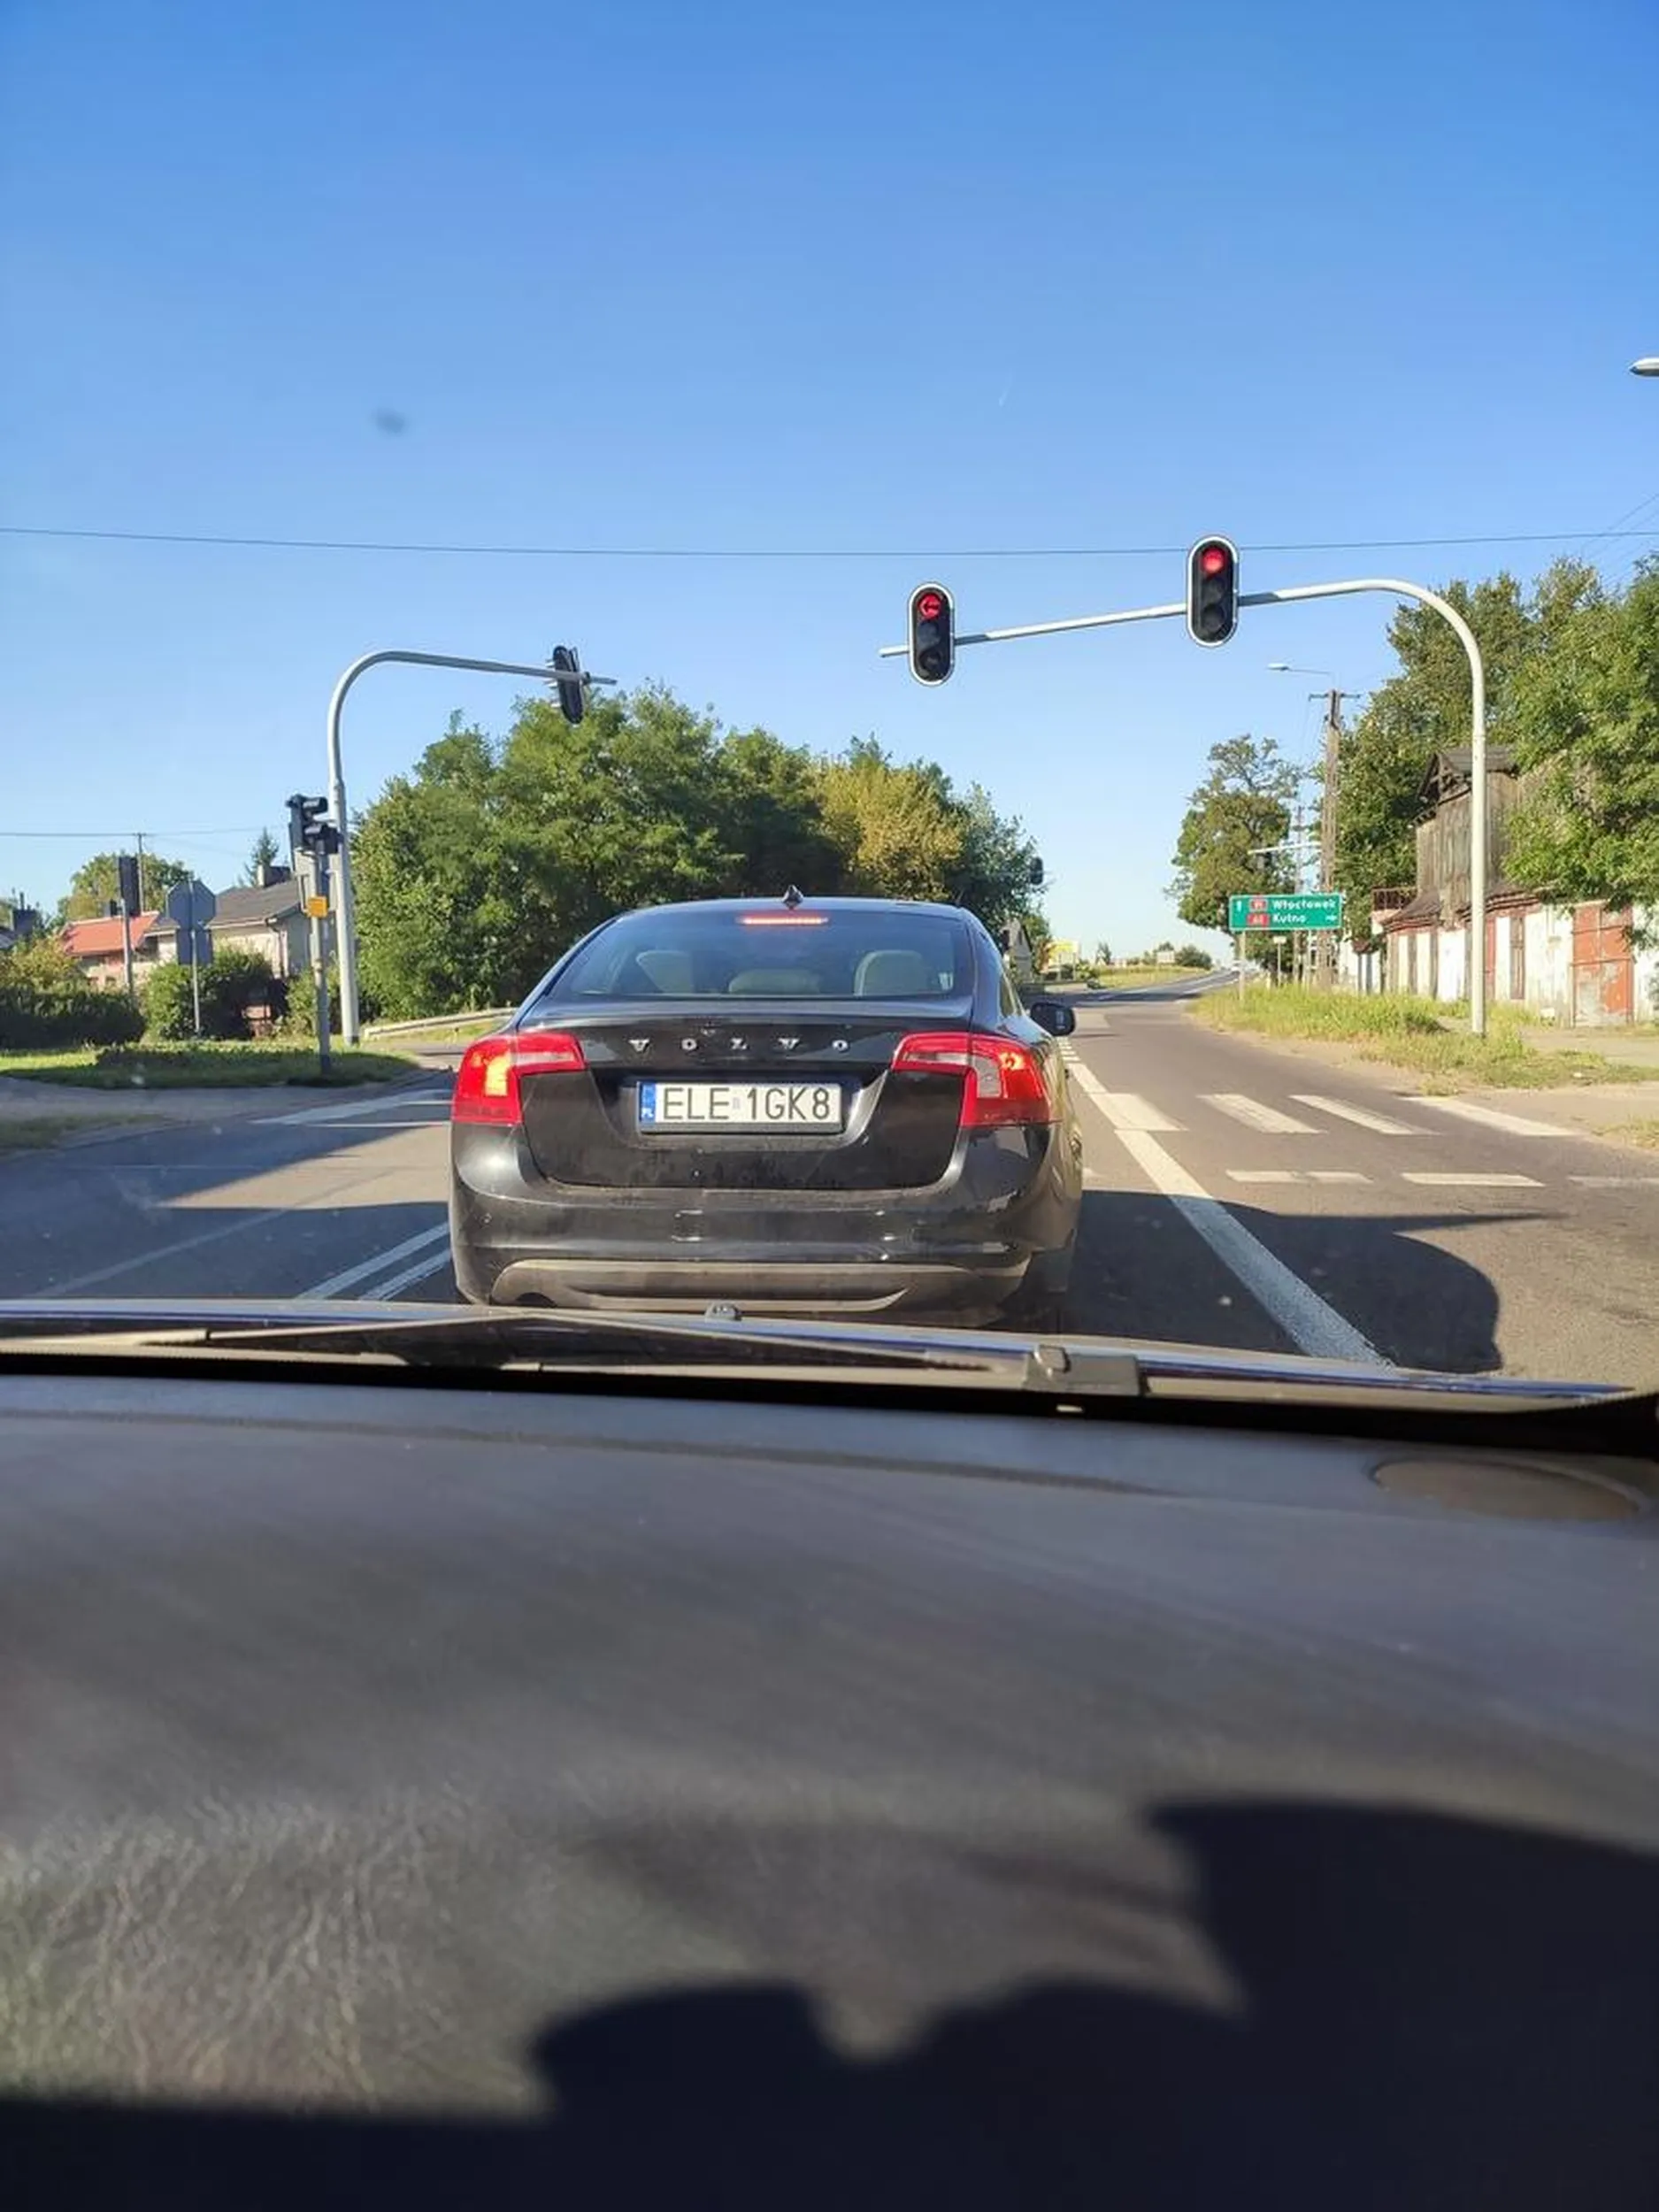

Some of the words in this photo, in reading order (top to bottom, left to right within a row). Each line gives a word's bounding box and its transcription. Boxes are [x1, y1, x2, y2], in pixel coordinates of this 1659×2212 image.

[1272, 913, 1307, 924] Kutno
[629, 1038, 848, 1052] VOLVO
[664, 1087, 730, 1120] ELE
[747, 1087, 830, 1120] 1GK8
